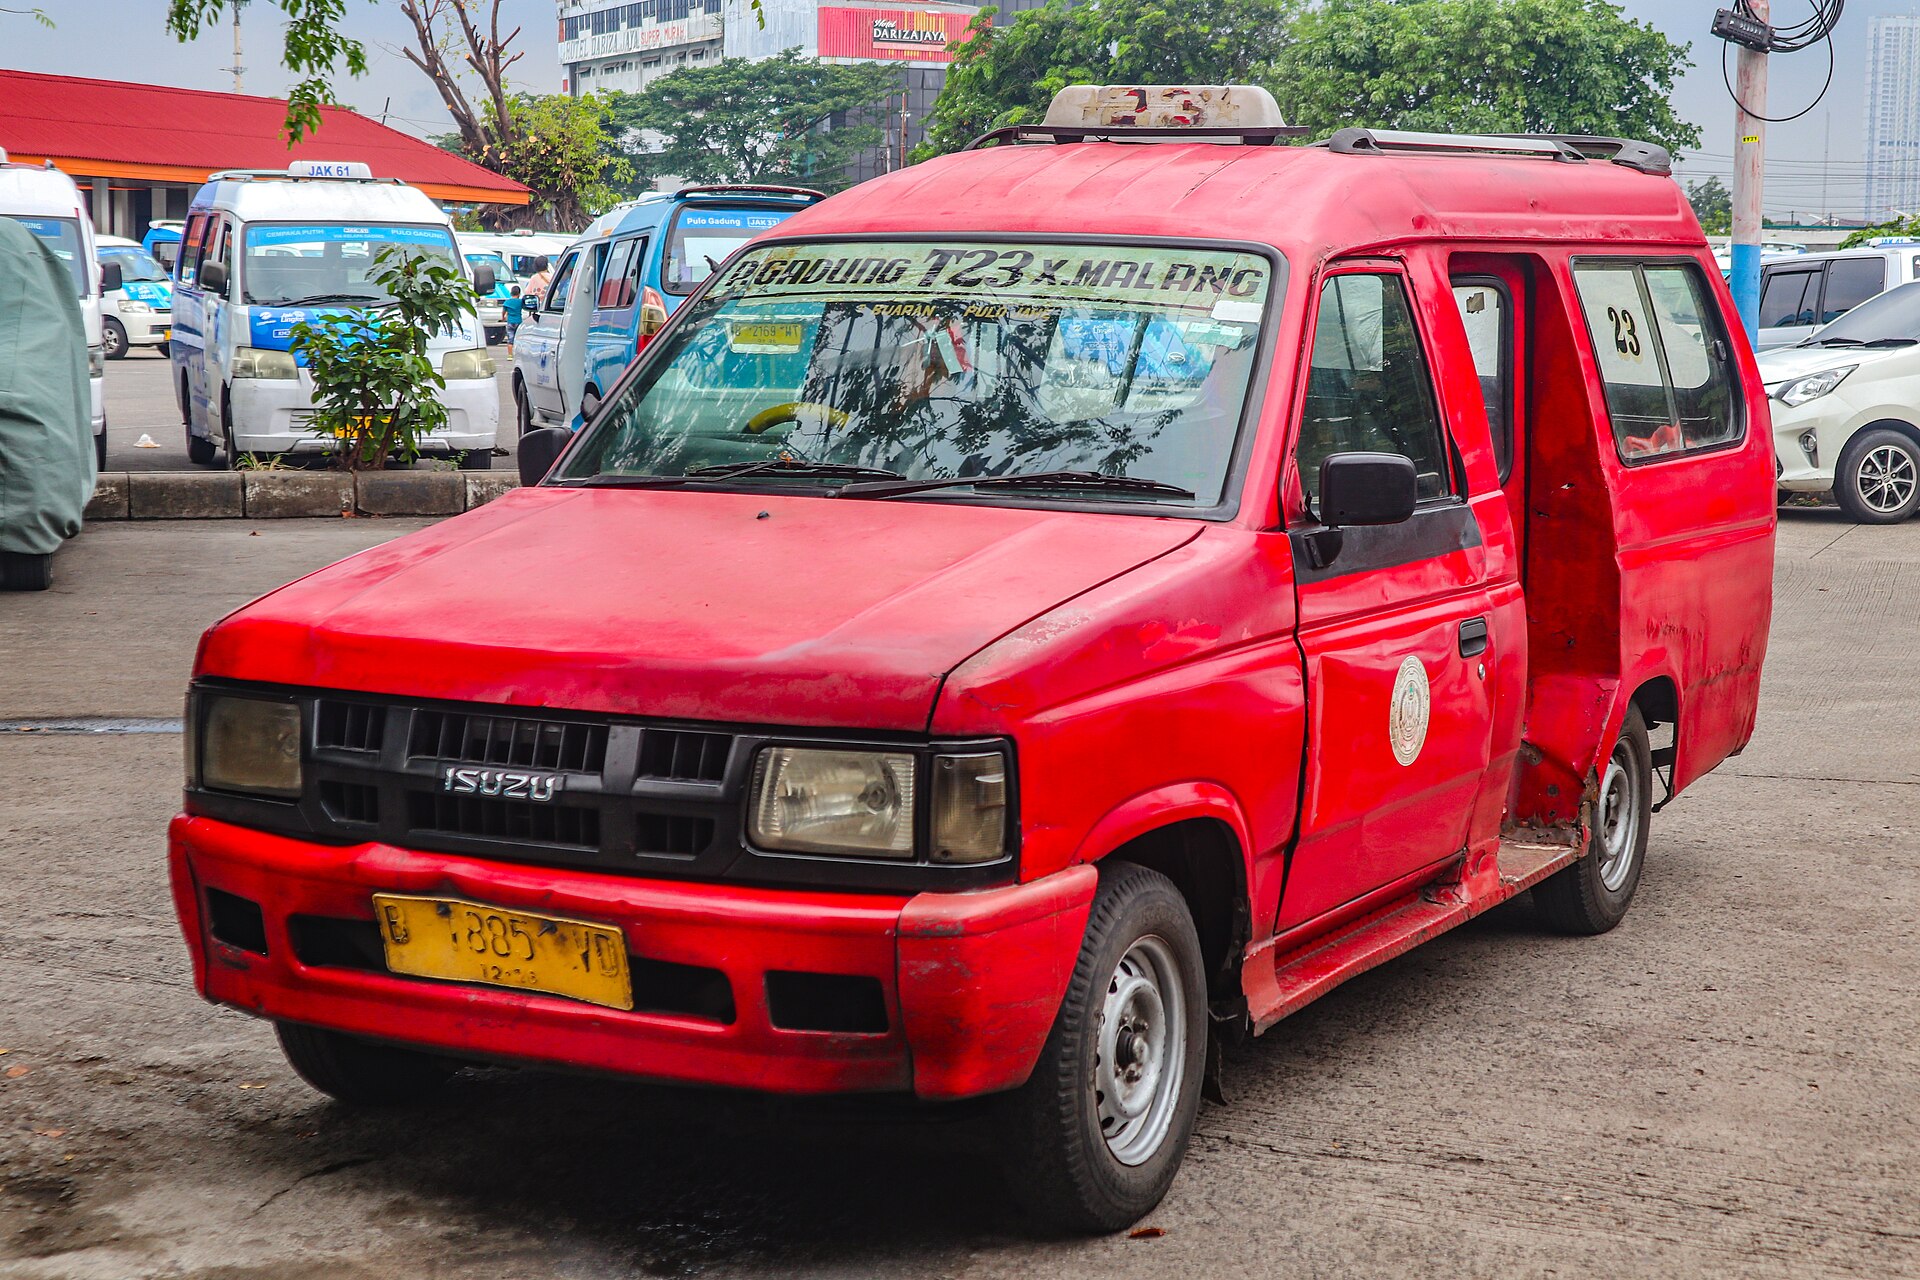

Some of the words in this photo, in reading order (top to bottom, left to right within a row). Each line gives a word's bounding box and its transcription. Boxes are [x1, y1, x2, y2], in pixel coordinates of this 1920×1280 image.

[640, 29, 660, 46] SUPER
[664, 24, 685, 41] MURAH
[308, 165, 333, 177] JAK
[336, 165, 350, 177] 61
[686, 217, 707, 225] Pulo
[708, 217, 741, 227] Gadung
[917, 248, 1035, 288] T23
[872, 303, 937, 317] BUARAN
[752, 325, 777, 337] 2169
[1607, 306, 1642, 357] 23
[444, 766, 556, 802] ISUZU
